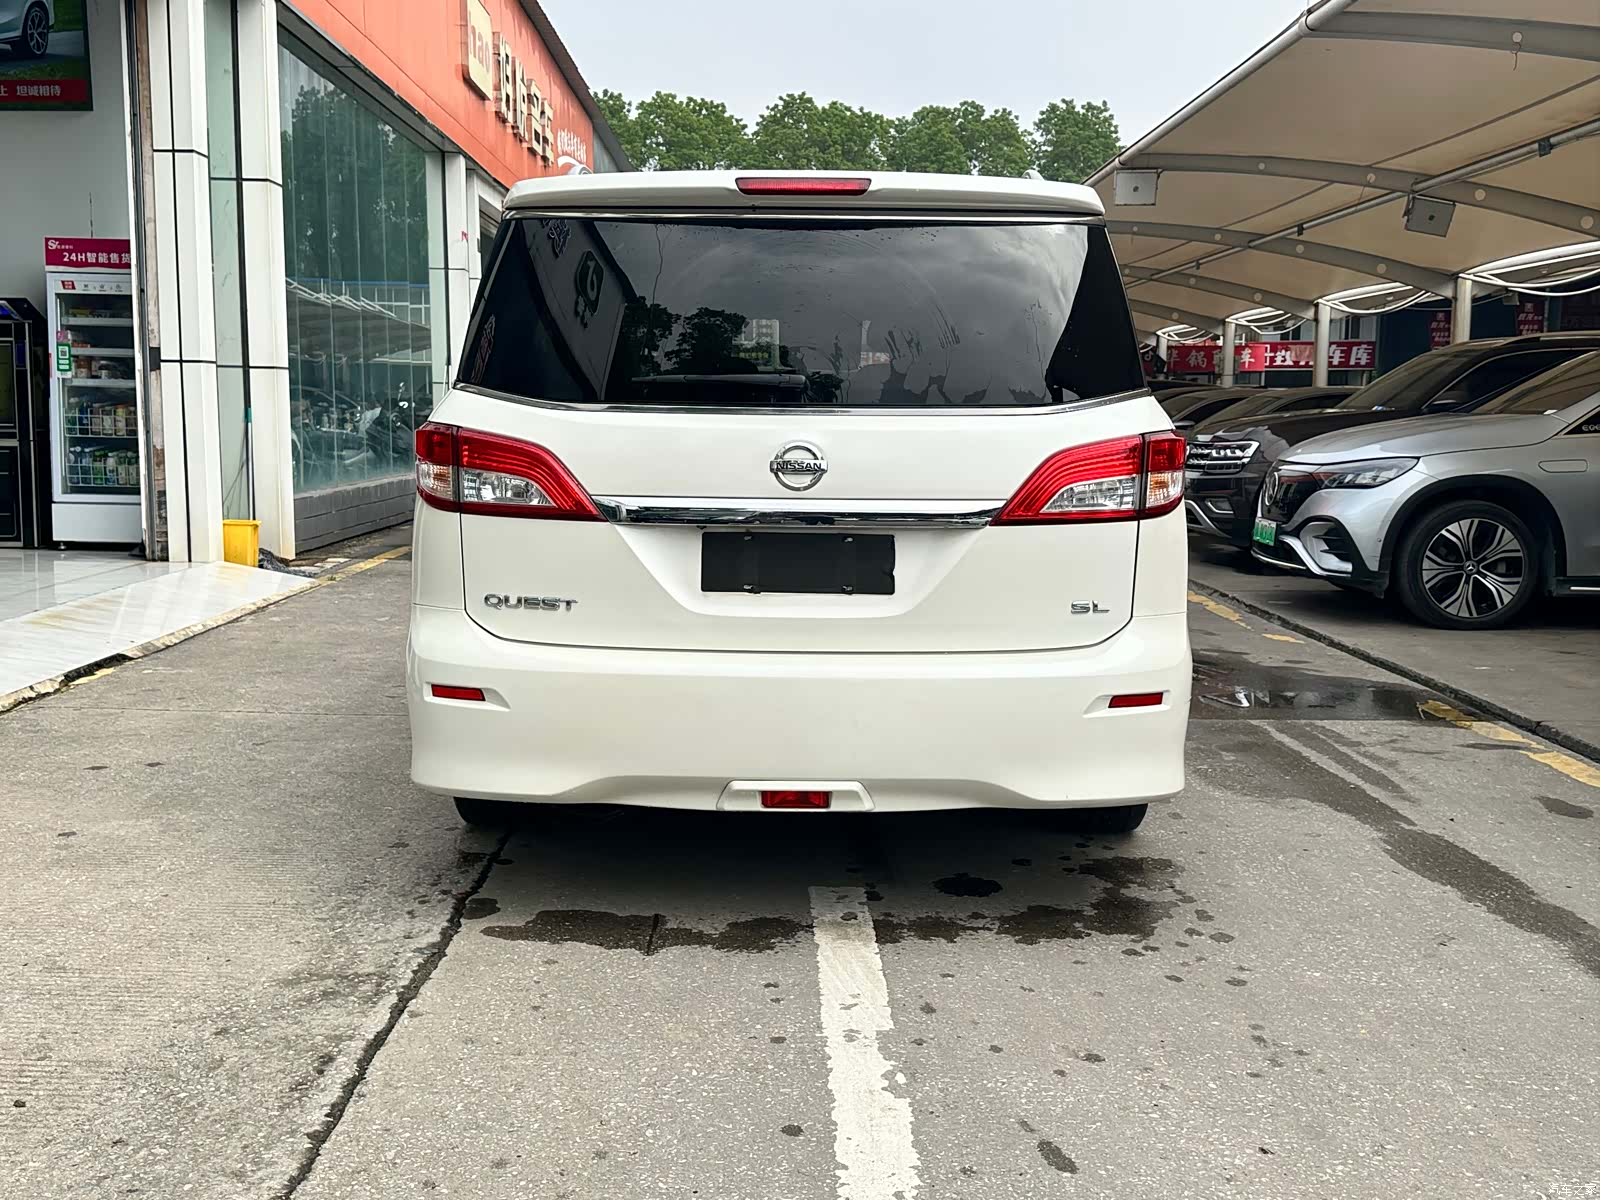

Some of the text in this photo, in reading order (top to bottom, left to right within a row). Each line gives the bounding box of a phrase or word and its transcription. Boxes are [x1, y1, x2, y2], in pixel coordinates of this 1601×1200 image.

[16, 85, 61, 97] 坦诚相待
[776, 462, 822, 470] NISSAN
[483, 594, 578, 612] QUEST
[1071, 600, 1110, 614] SL
